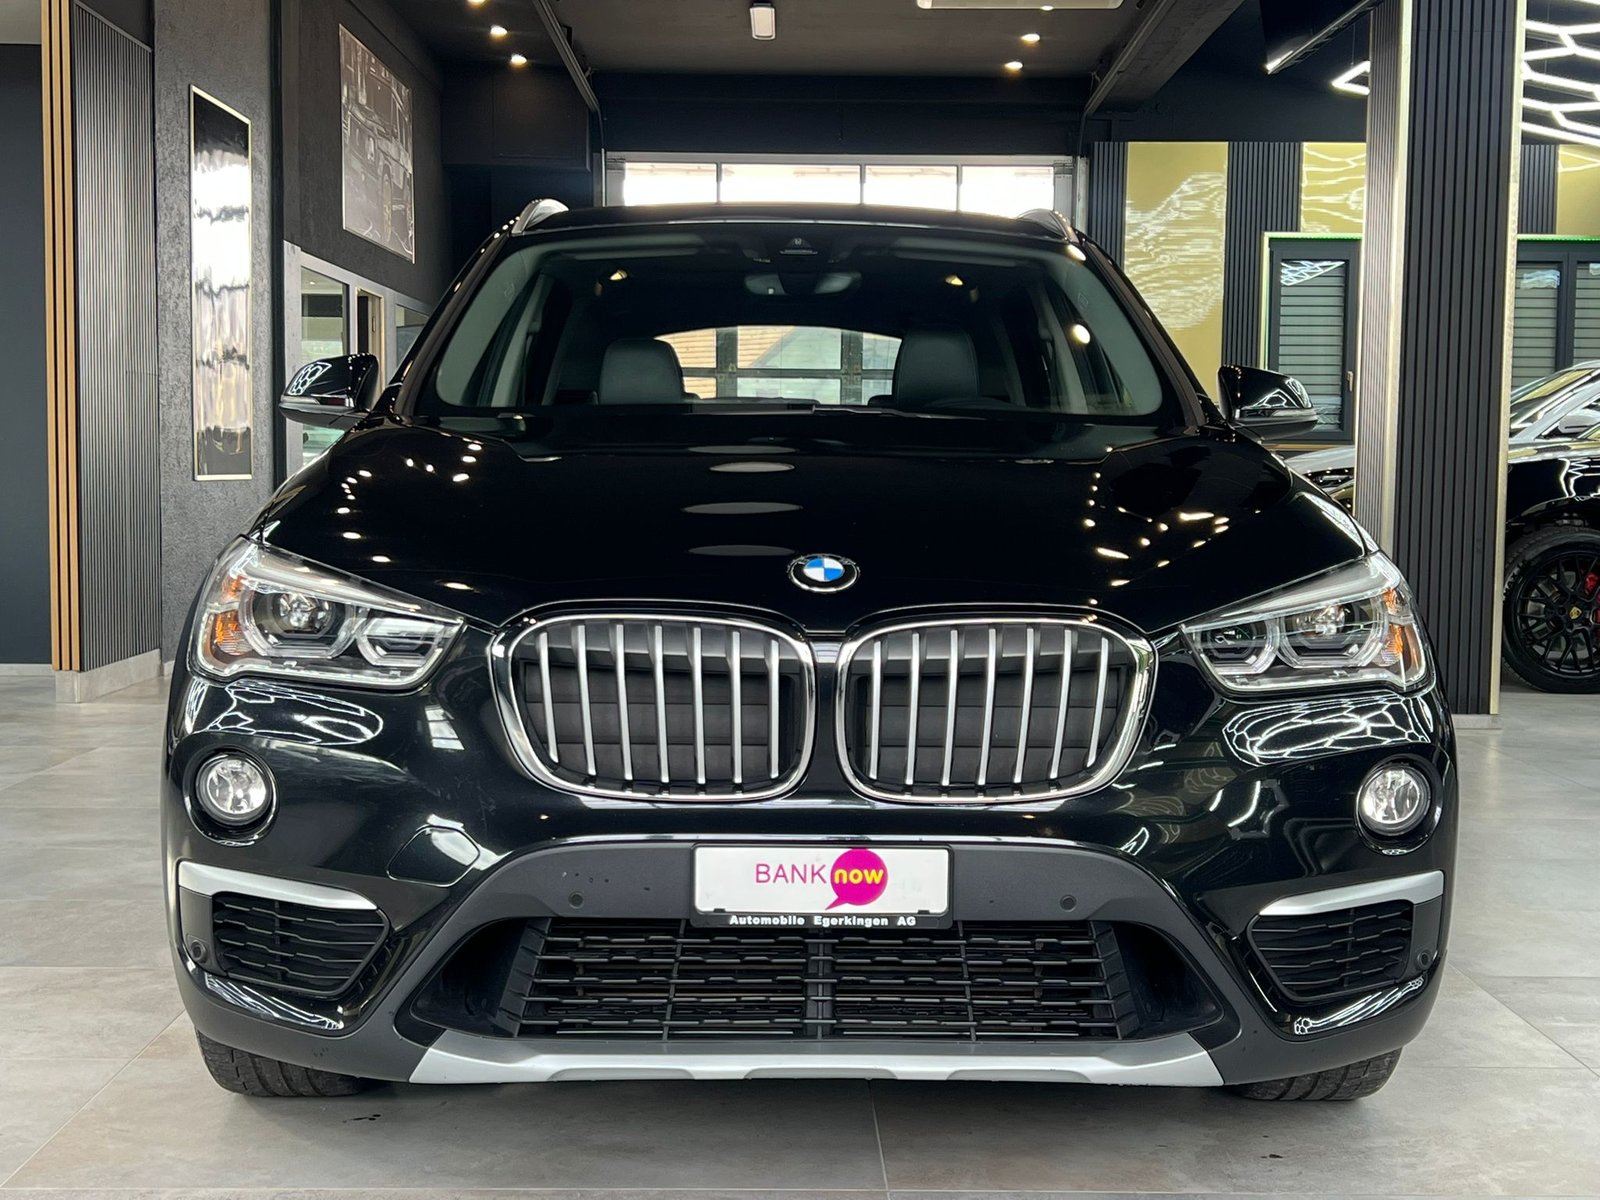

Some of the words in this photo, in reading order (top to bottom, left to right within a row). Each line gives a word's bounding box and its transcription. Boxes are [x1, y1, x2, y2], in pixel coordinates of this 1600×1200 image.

[755, 863, 827, 884] BANK
[833, 867, 885, 885] now
[729, 914, 805, 926] Automobile
[813, 914, 889, 927] Egerkingen
[897, 914, 917, 927] AG
